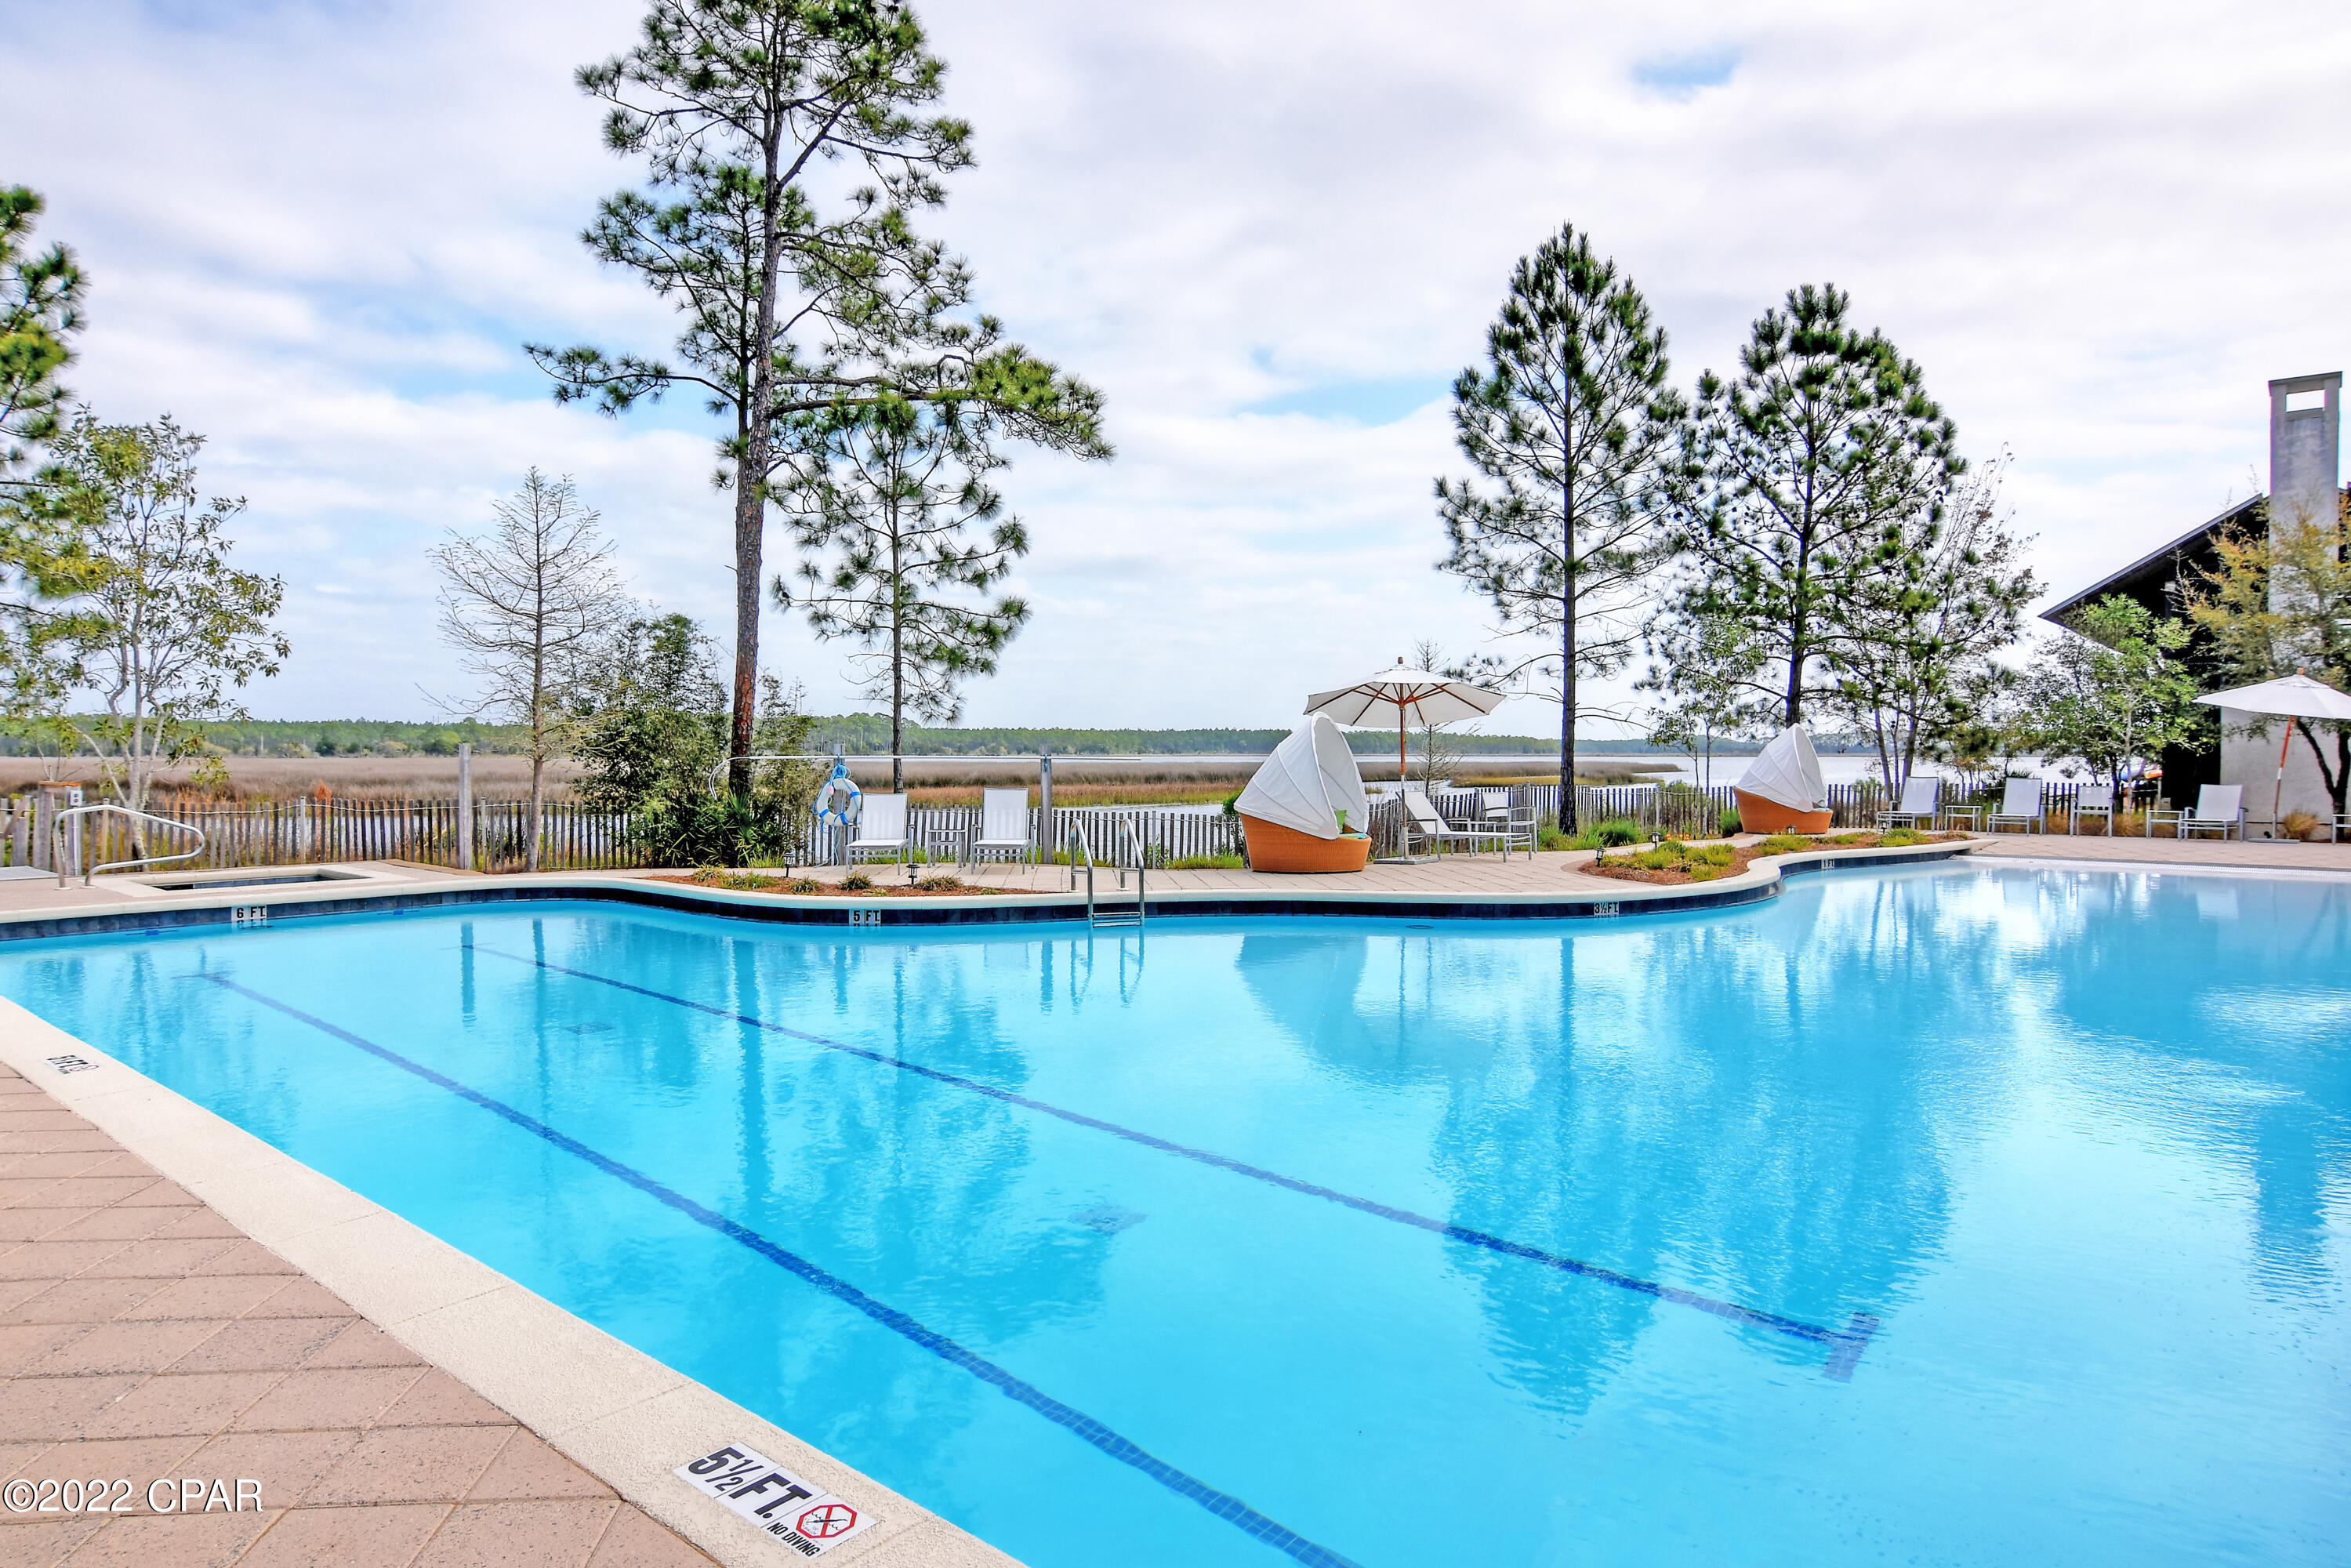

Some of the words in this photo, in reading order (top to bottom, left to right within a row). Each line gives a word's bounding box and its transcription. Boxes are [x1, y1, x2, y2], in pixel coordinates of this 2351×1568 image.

[237, 907, 245, 918] 6
[250, 906, 266, 918] FT.
[853, 909, 861, 922] 5
[865, 909, 880, 922] FT.
[728, 1472, 813, 1519] FT.
[766, 1522, 789, 1536] NO
[783, 1531, 822, 1557] DIVING
